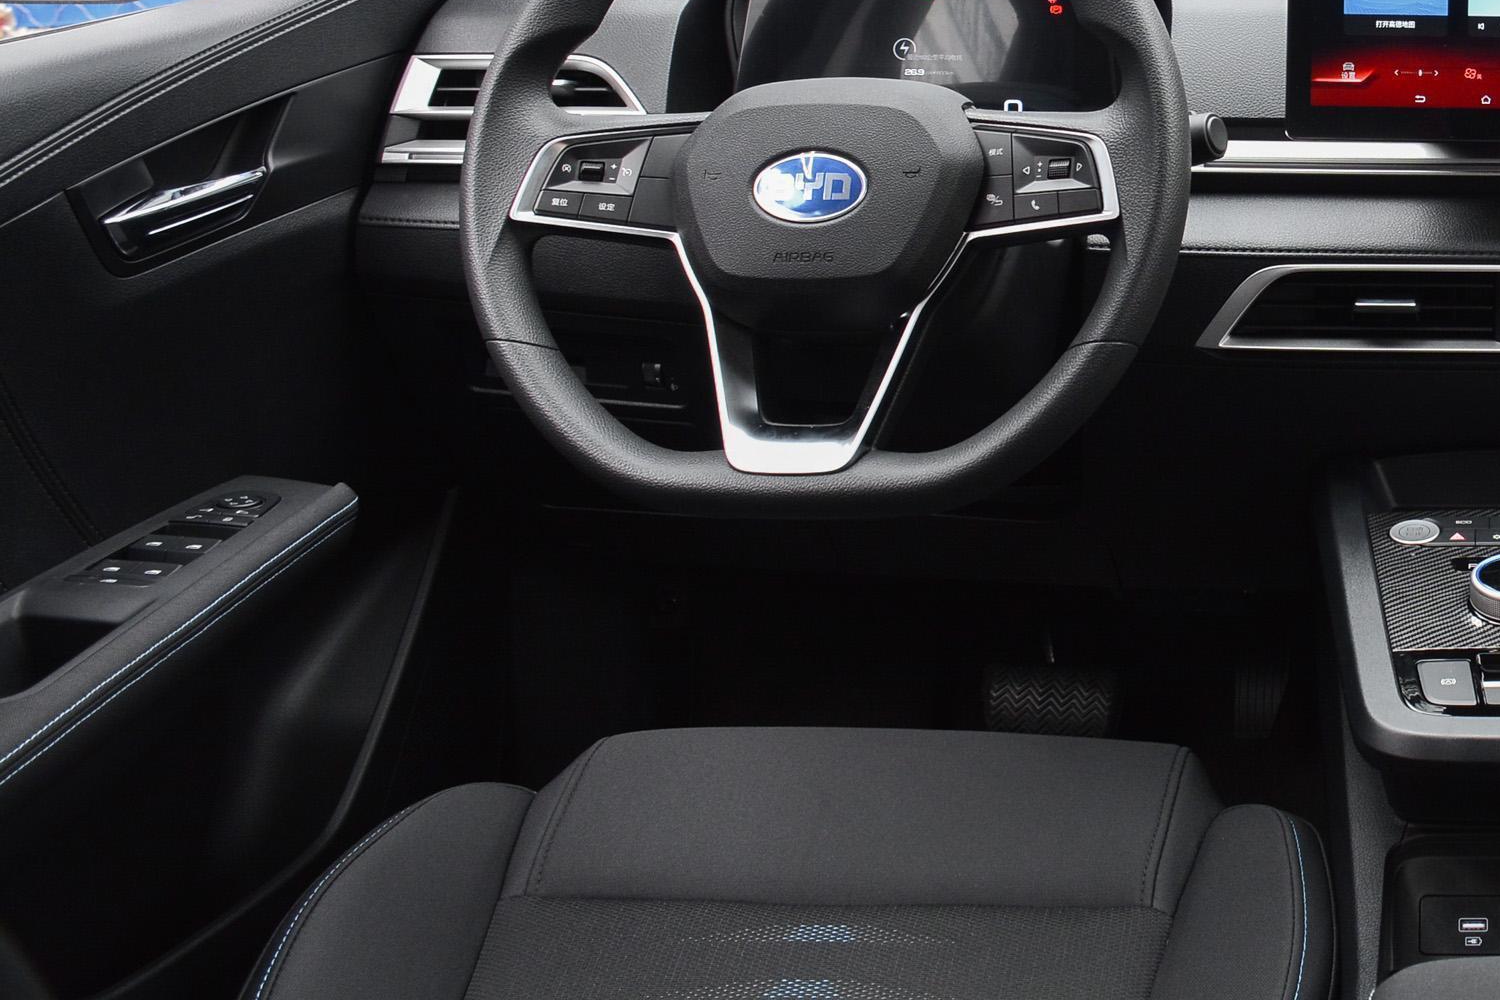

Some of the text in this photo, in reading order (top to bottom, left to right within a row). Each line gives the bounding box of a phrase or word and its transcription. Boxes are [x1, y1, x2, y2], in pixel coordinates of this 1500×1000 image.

[1376, 20, 1416, 29] 打开高德地图
[1342, 71, 1356, 80] 设置
[988, 148, 1004, 157] 模式
[551, 198, 568, 207] 复位
[598, 202, 616, 212] 设定
[772, 251, 835, 263] AIRBAG
